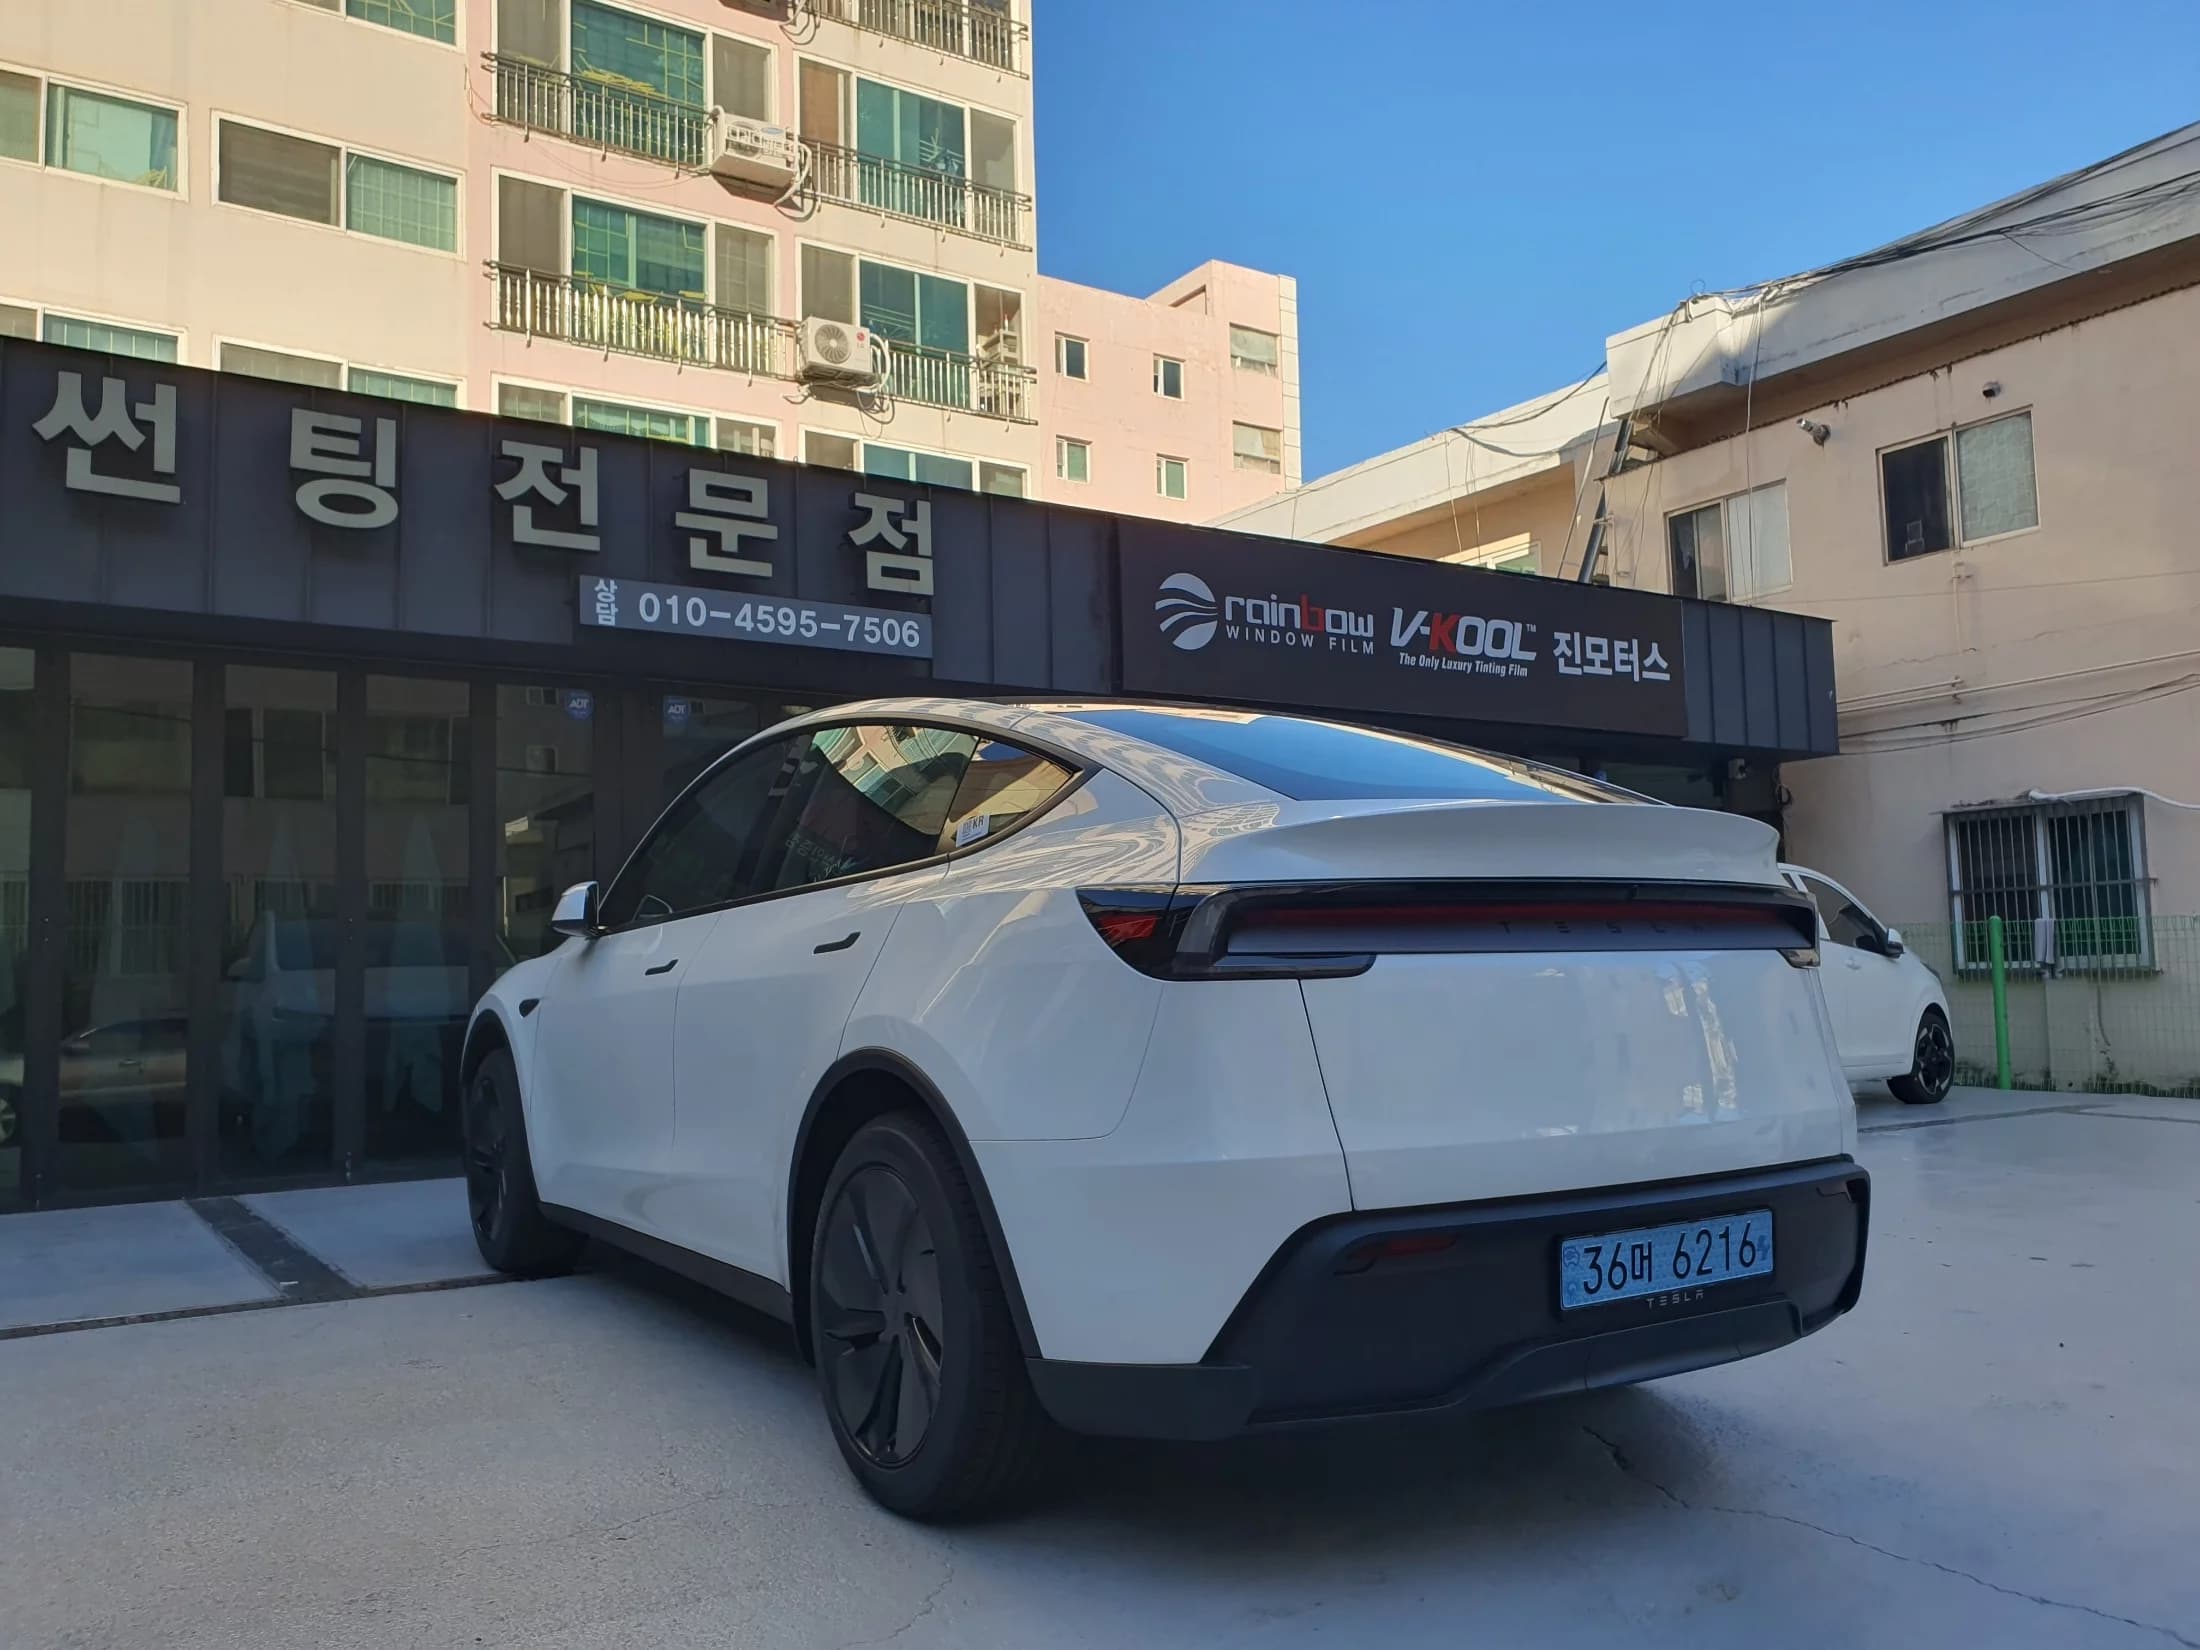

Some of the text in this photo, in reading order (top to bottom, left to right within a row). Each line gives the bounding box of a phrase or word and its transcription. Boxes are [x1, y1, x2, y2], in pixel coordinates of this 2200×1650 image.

[32, 371, 934, 596] 썬팅전문점
[594, 579, 920, 648] 상담 010-4595-7506
[1225, 593, 1374, 638] rainbow
[1390, 607, 1537, 661] V-KOOL
[1226, 624, 1374, 655] WINDOW FILM
[1553, 631, 1671, 682] 진모터스
[1399, 652, 1528, 678] The Only Luxury Tinting Film
[568, 697, 590, 709] ADT
[668, 704, 687, 715] ADT
[1583, 1219, 1757, 1295] 36머 6216
[1646, 1288, 1705, 1310] TESLA
